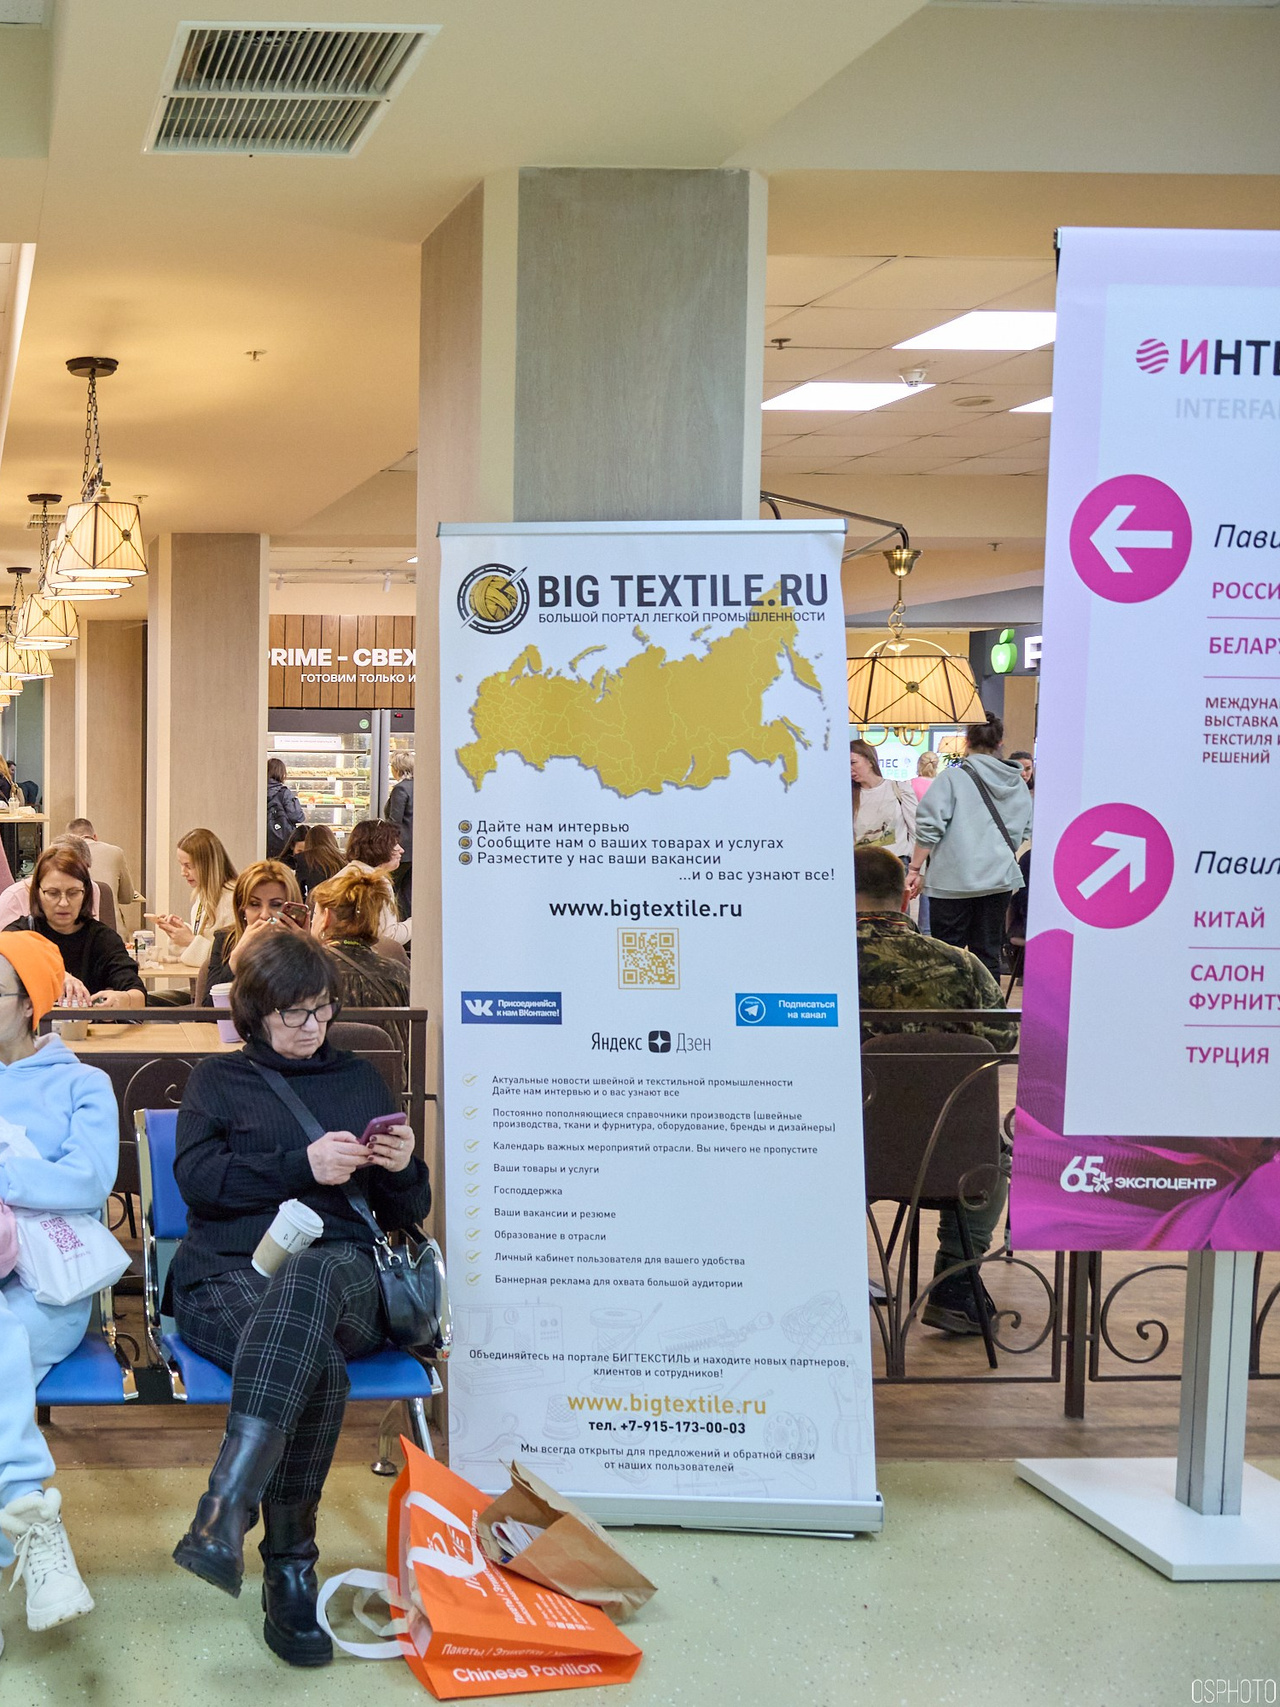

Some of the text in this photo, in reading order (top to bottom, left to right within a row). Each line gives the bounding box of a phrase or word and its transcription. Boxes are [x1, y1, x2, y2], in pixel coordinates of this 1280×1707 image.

[1176, 398, 1280, 419] INTERFA
[538, 573, 828, 608] BIG TEXTILE.RU
[1212, 582, 1280, 600] РОССИ
[539, 611, 825, 623] БОЛЬШОЙ ПОРТАЛ ЛЕГКОЙ ПРОМЫШЛЕННОСТИ
[1209, 637, 1280, 655] БЕЛАР
[268, 648, 332, 667] RIME
[301, 673, 356, 682] ГОТОВИМ
[359, 673, 405, 682] ТОЛЬКО
[1205, 697, 1280, 712] МЕЖДУНА
[1204, 715, 1279, 728] ВЫСТАВКА
[1203, 733, 1273, 746] ТЕКСТИЛЯ
[1202, 749, 1270, 764] РЕШЕНИЙ
[476, 820, 629, 835] Дайте нам интервью
[477, 836, 783, 852] Сообщите нам о ваших товарах и услугах
[478, 852, 721, 867] Разместите у нас ваши вакансии
[679, 868, 834, 883] ...и о вас узнают все!
[549, 899, 742, 921] www.bigtextile.ru
[1194, 906, 1265, 928] КИТАЙ
[1190, 964, 1264, 982] САЛОН
[498, 999, 556, 1008] Присоединяйся
[778, 1000, 835, 1009] Подписаться
[787, 1011, 826, 1019] на канал
[591, 1032, 711, 1053] Яндекс Дзен
[1186, 1046, 1269, 1067] ТУРЦИЯ
[492, 1075, 549, 1085] Актуальные
[593, 1077, 635, 1085] швейной
[646, 1078, 705, 1086] текстильной
[708, 1080, 793, 1088] промышленности
[492, 1086, 521, 1096] Дайте
[544, 1089, 591, 1097] интервью
[628, 1090, 661, 1098] узнают
[493, 1108, 802, 1121] Постоянно пополняющиеся справочники производств (швейные
[493, 1121, 561, 1129] производства,
[602, 1121, 655, 1131] фурнитура,
[657, 1121, 727, 1132] оборудование,
[730, 1122, 766, 1132] бренды
[777, 1123, 835, 1133] дизайнеры)
[493, 1141, 545, 1152] Календарь
[588, 1143, 650, 1153] мероприятий
[653, 1145, 693, 1154] отрасли.
[696, 1144, 711, 1153] Вы
[764, 1147, 818, 1155] пропустите
[493, 1163, 520, 1172] Ваши
[522, 1166, 557, 1174] товары
[568, 1167, 599, 1175] услуги
[1114, 1177, 1217, 1190] ЭКСПОЦЕНТР
[494, 1185, 563, 1197] Господдержка
[494, 1208, 520, 1216] Ваши
[494, 1230, 557, 1240] Образование
[568, 1234, 606, 1242] отрасли
[494, 1252, 533, 1261] Личный
[535, 1253, 574, 1262] кабинет
[644, 1257, 661, 1265] для
[702, 1256, 745, 1266] удобства
[495, 1275, 547, 1286] Баннерная
[550, 1278, 591, 1286] реклама
[647, 1278, 689, 1287] большой
[692, 1280, 743, 1289] аудитории
[469, 1349, 549, 1360] Объединяйтесь
[568, 1354, 609, 1363] портале
[613, 1353, 690, 1363] БИГТЕКСТИЛЬ
[703, 1357, 751, 1366] находите
[790, 1358, 849, 1368] партнеров,
[593, 1368, 642, 1376] клиентов
[654, 1369, 723, 1379] сотрудников!
[567, 1393, 766, 1417] www.bigtextile.ru
[588, 1420, 745, 1434] тел. +7-915-173-00-03
[521, 1443, 538, 1453] Мы
[541, 1446, 576, 1455] всегда
[579, 1447, 623, 1457] открыты
[626, 1449, 645, 1457] для
[649, 1449, 720, 1458] предложений
[733, 1449, 782, 1460] обратной
[785, 1452, 815, 1460] связи
[618, 1462, 652, 1470] наших
[655, 1463, 734, 1472] пользователей
[441, 1643, 484, 1657] Пакеты
[453, 1662, 602, 1682] Chinese Pavilion
